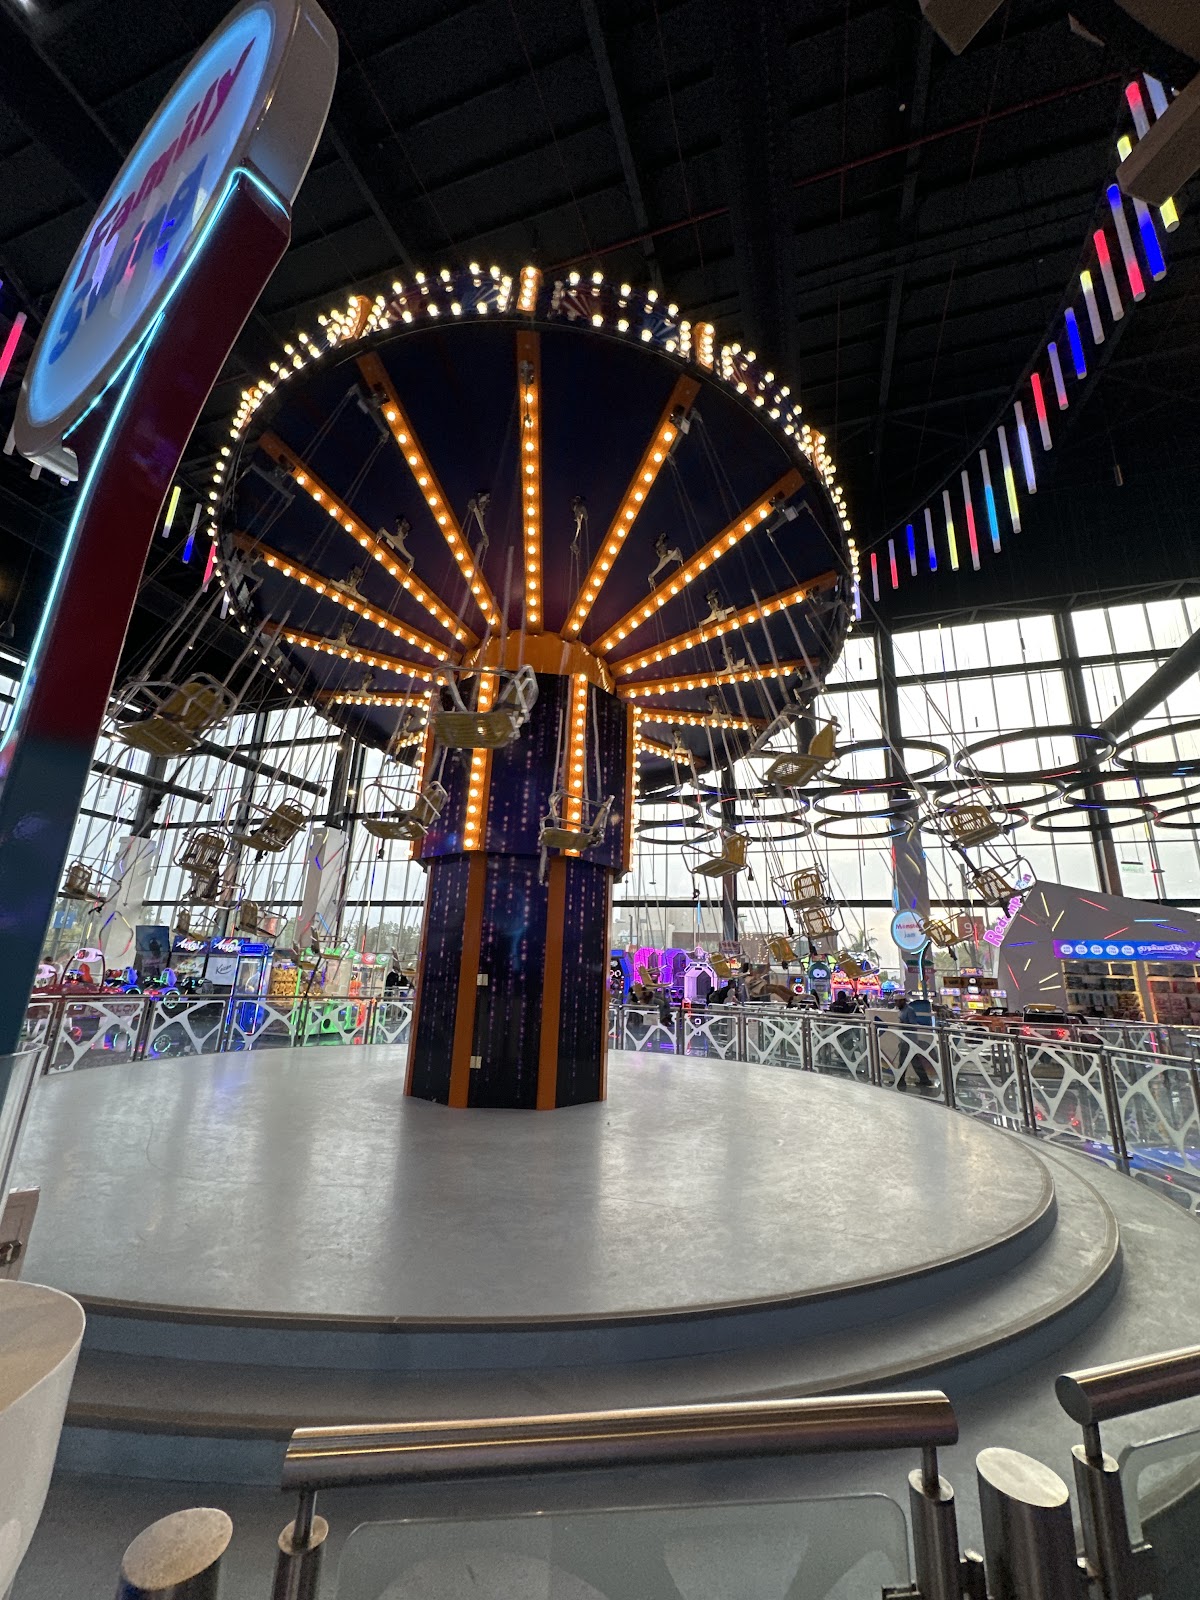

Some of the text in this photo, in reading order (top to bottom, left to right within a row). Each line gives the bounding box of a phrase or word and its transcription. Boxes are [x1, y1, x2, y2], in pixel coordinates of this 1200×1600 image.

[48, 153, 208, 365] Swing
[73, 37, 257, 292] Family
[983, 873, 1032, 948] Redmpon
